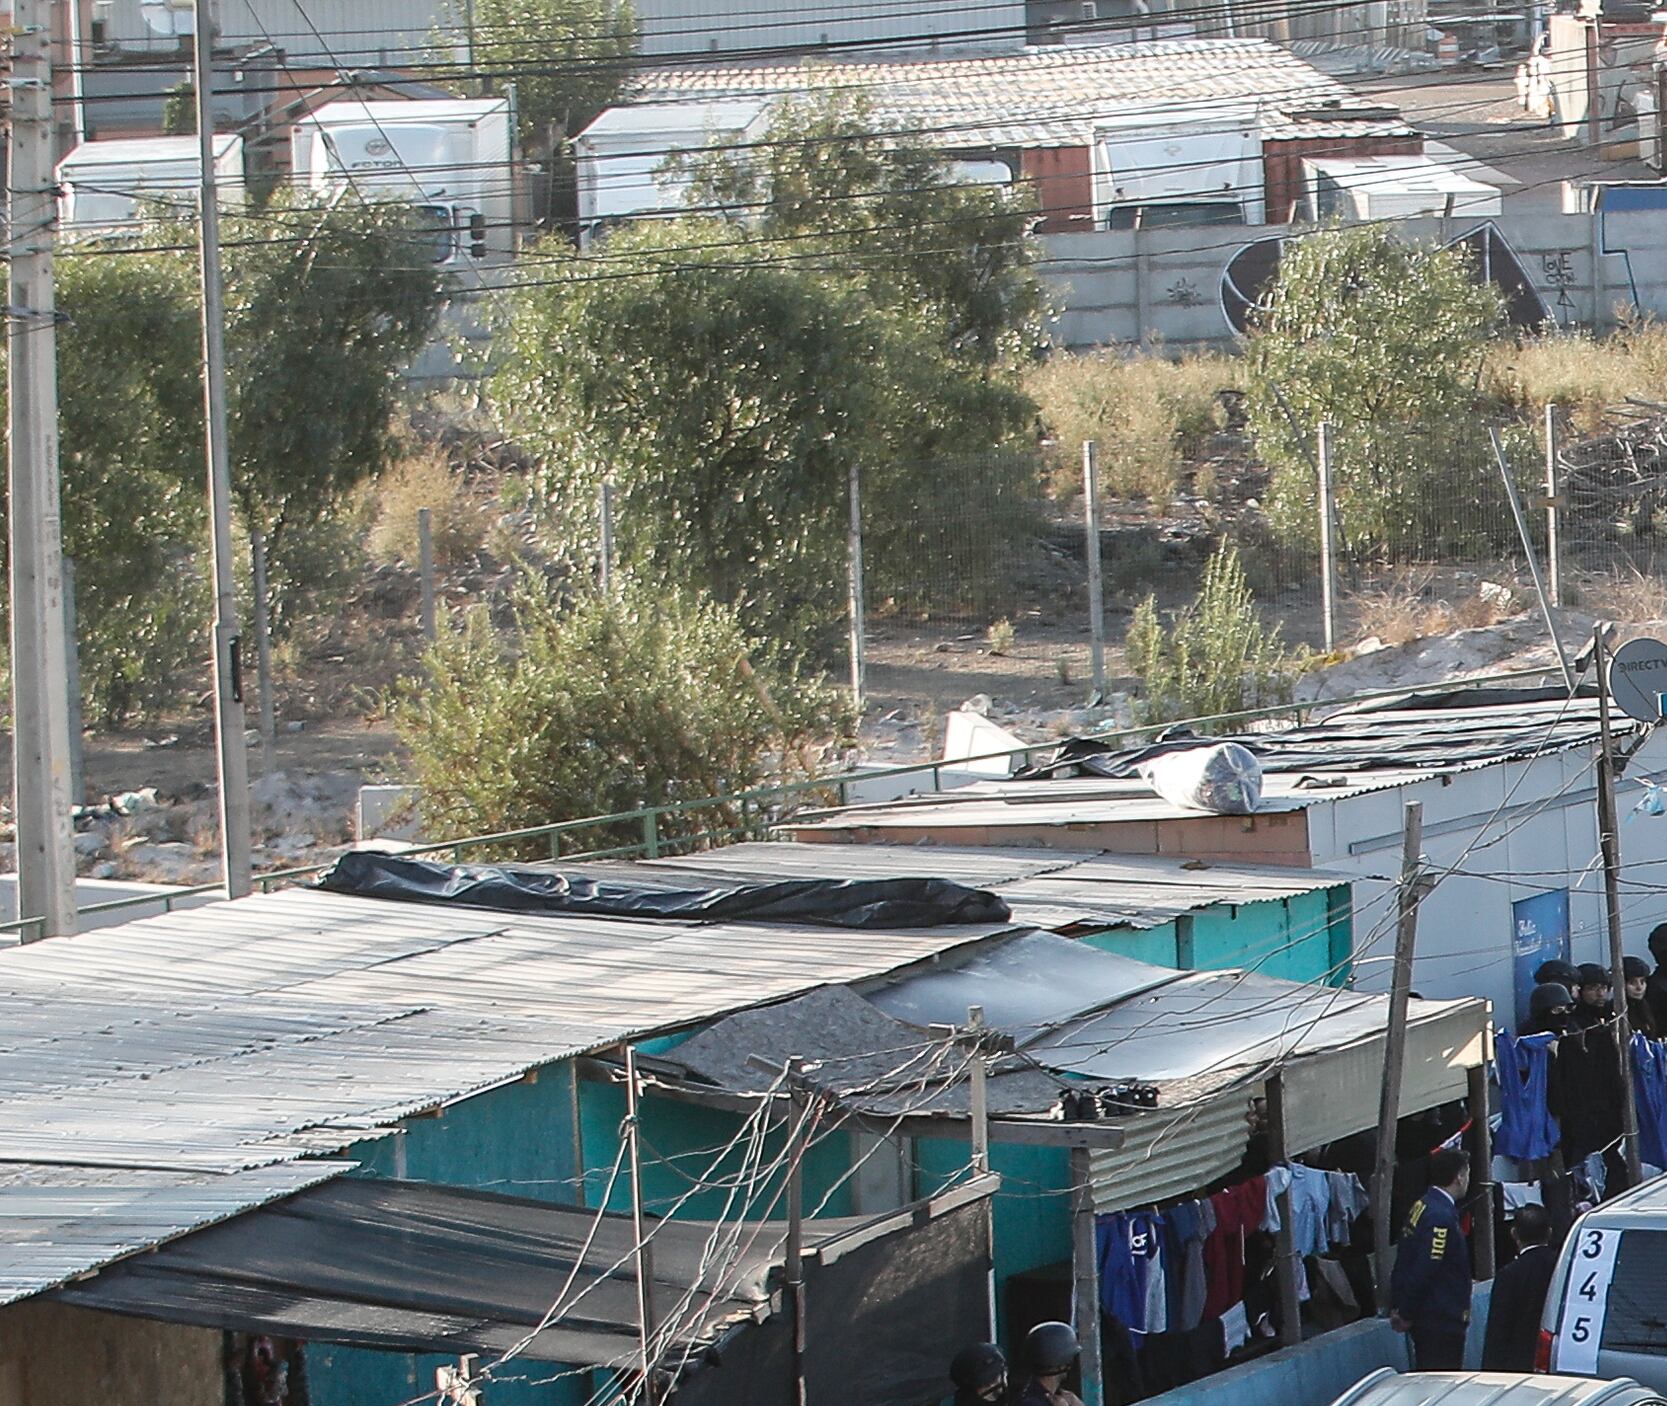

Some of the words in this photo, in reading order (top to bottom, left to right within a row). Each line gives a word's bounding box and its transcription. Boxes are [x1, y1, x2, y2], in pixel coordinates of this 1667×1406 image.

[1431, 1226, 1448, 1255] PDI
[1582, 1231, 1604, 1259] 3
[1579, 1271, 1597, 1302] 4
[1571, 1316, 1591, 1342] 5
